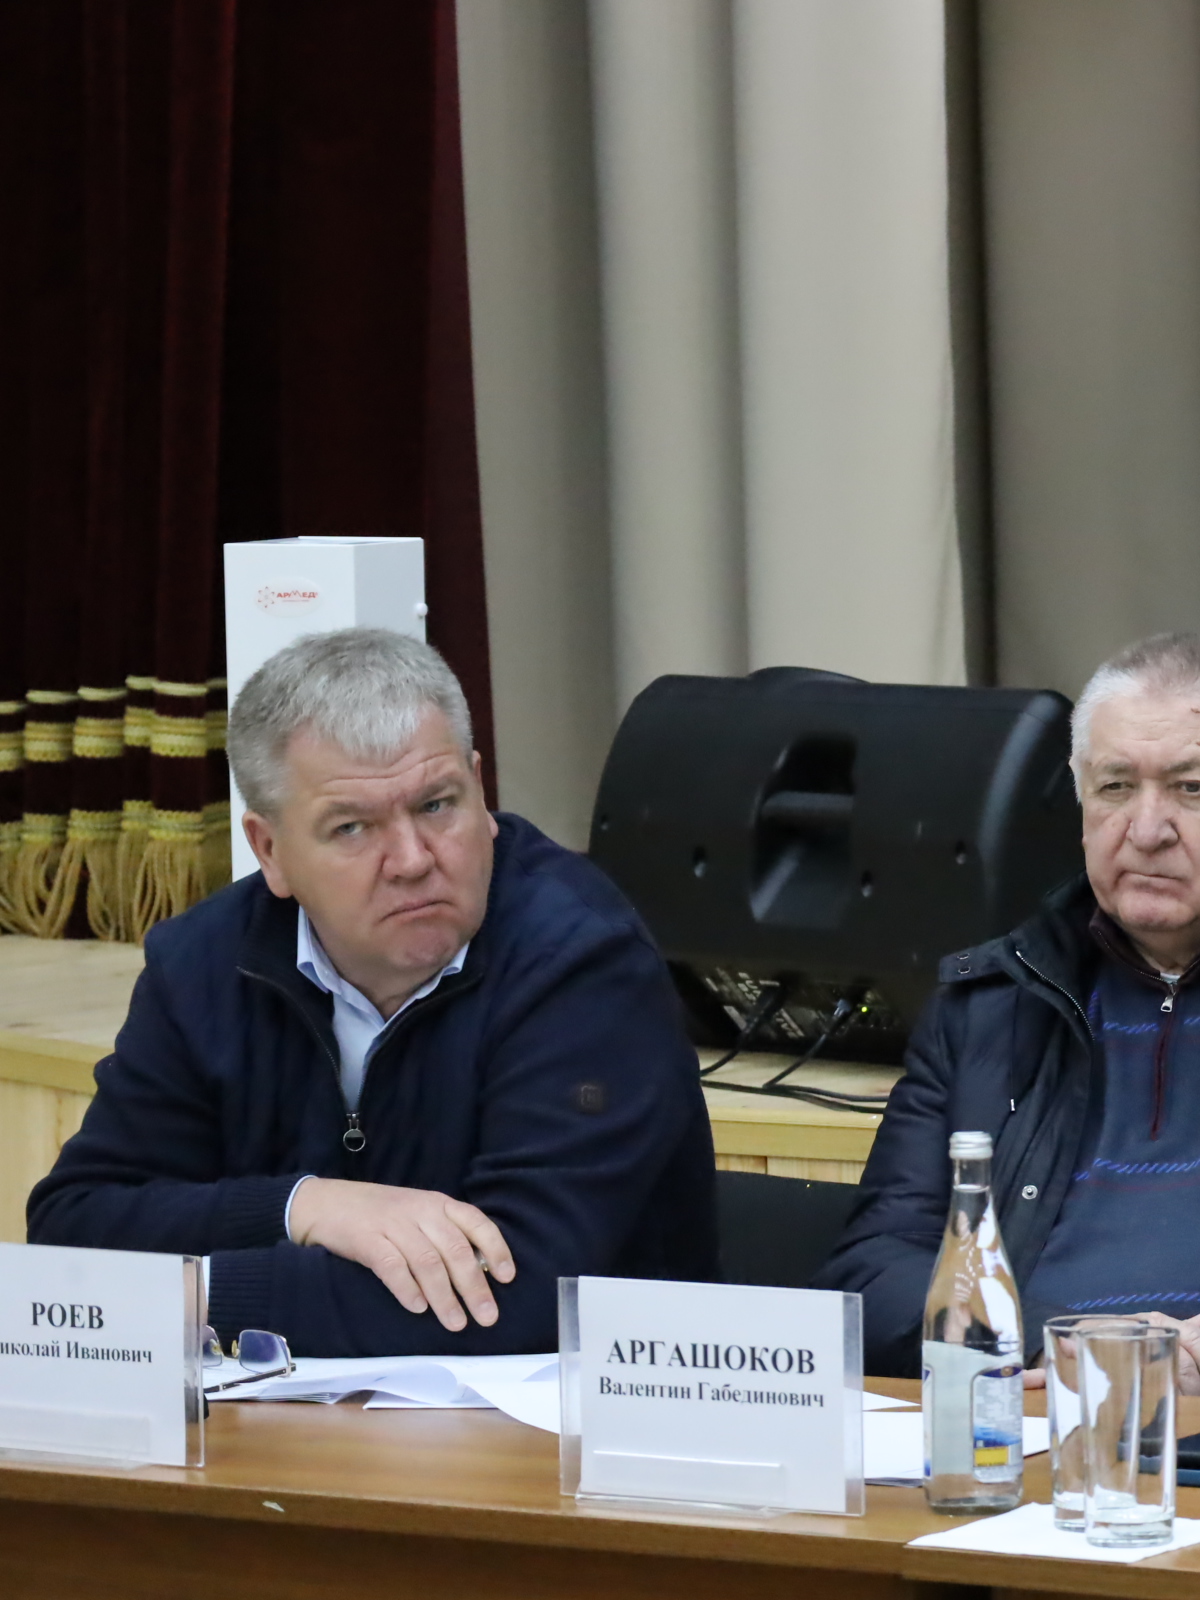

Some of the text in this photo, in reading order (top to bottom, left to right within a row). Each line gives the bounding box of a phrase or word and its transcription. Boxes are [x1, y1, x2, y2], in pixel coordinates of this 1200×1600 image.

[31, 1302, 104, 1330] РОЕВ
[66, 1340, 152, 1364] Иванович
[606, 1339, 815, 1374] АРГАШОКОВ
[599, 1376, 824, 1408] Валентин Габединович
